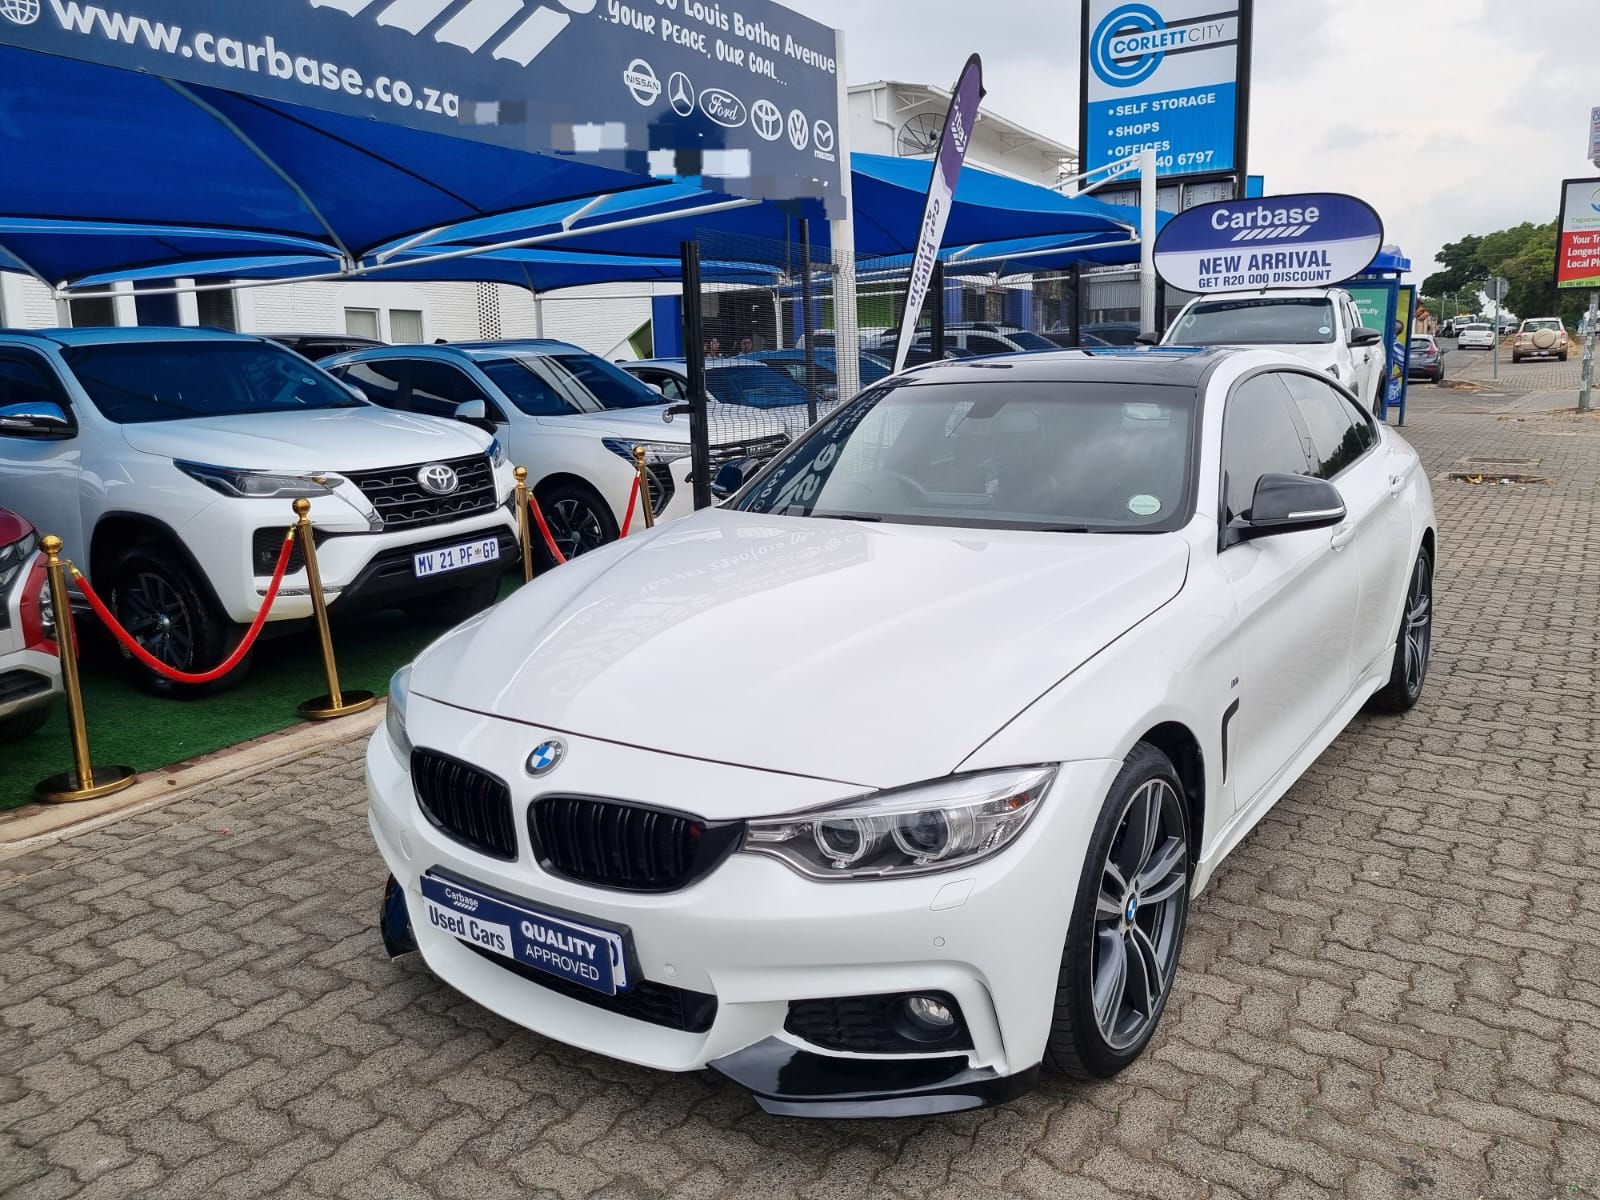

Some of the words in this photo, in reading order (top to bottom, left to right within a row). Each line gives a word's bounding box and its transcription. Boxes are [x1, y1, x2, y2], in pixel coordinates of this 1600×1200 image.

[684, 0, 730, 32] Louis
[732, 12, 781, 52] Botha
[784, 34, 837, 74] Avenue
[50, 0, 459, 118] www.carbase.co.za
[626, 74, 659, 91] NISSAN
[708, 92, 738, 121] Ford
[1116, 102, 1148, 116] SELF
[1152, 93, 1216, 111] STORAGE
[1115, 122, 1160, 137] SHOPS
[1115, 140, 1170, 157] OFFICES
[1178, 151, 1214, 165] 6797
[1211, 206, 1320, 230] Carbase
[1572, 235, 1591, 244] Your
[1199, 255, 1242, 275] NEW
[1247, 250, 1332, 271] ARRIVAL
[1567, 258, 1589, 268] Local
[1198, 277, 1219, 289] GET
[1223, 274, 1245, 286] R20
[1248, 273, 1269, 284] 000
[1273, 269, 1332, 283] DISCOUNT
[417, 554, 434, 573] MV
[439, 551, 455, 569] 21
[459, 546, 473, 564] PF
[482, 541, 496, 559] GP
[445, 888, 479, 908] Carbase
[429, 905, 466, 936] Used
[469, 921, 505, 951] Cars
[521, 920, 597, 960] QUALITY
[526, 943, 599, 981] APPROVED
